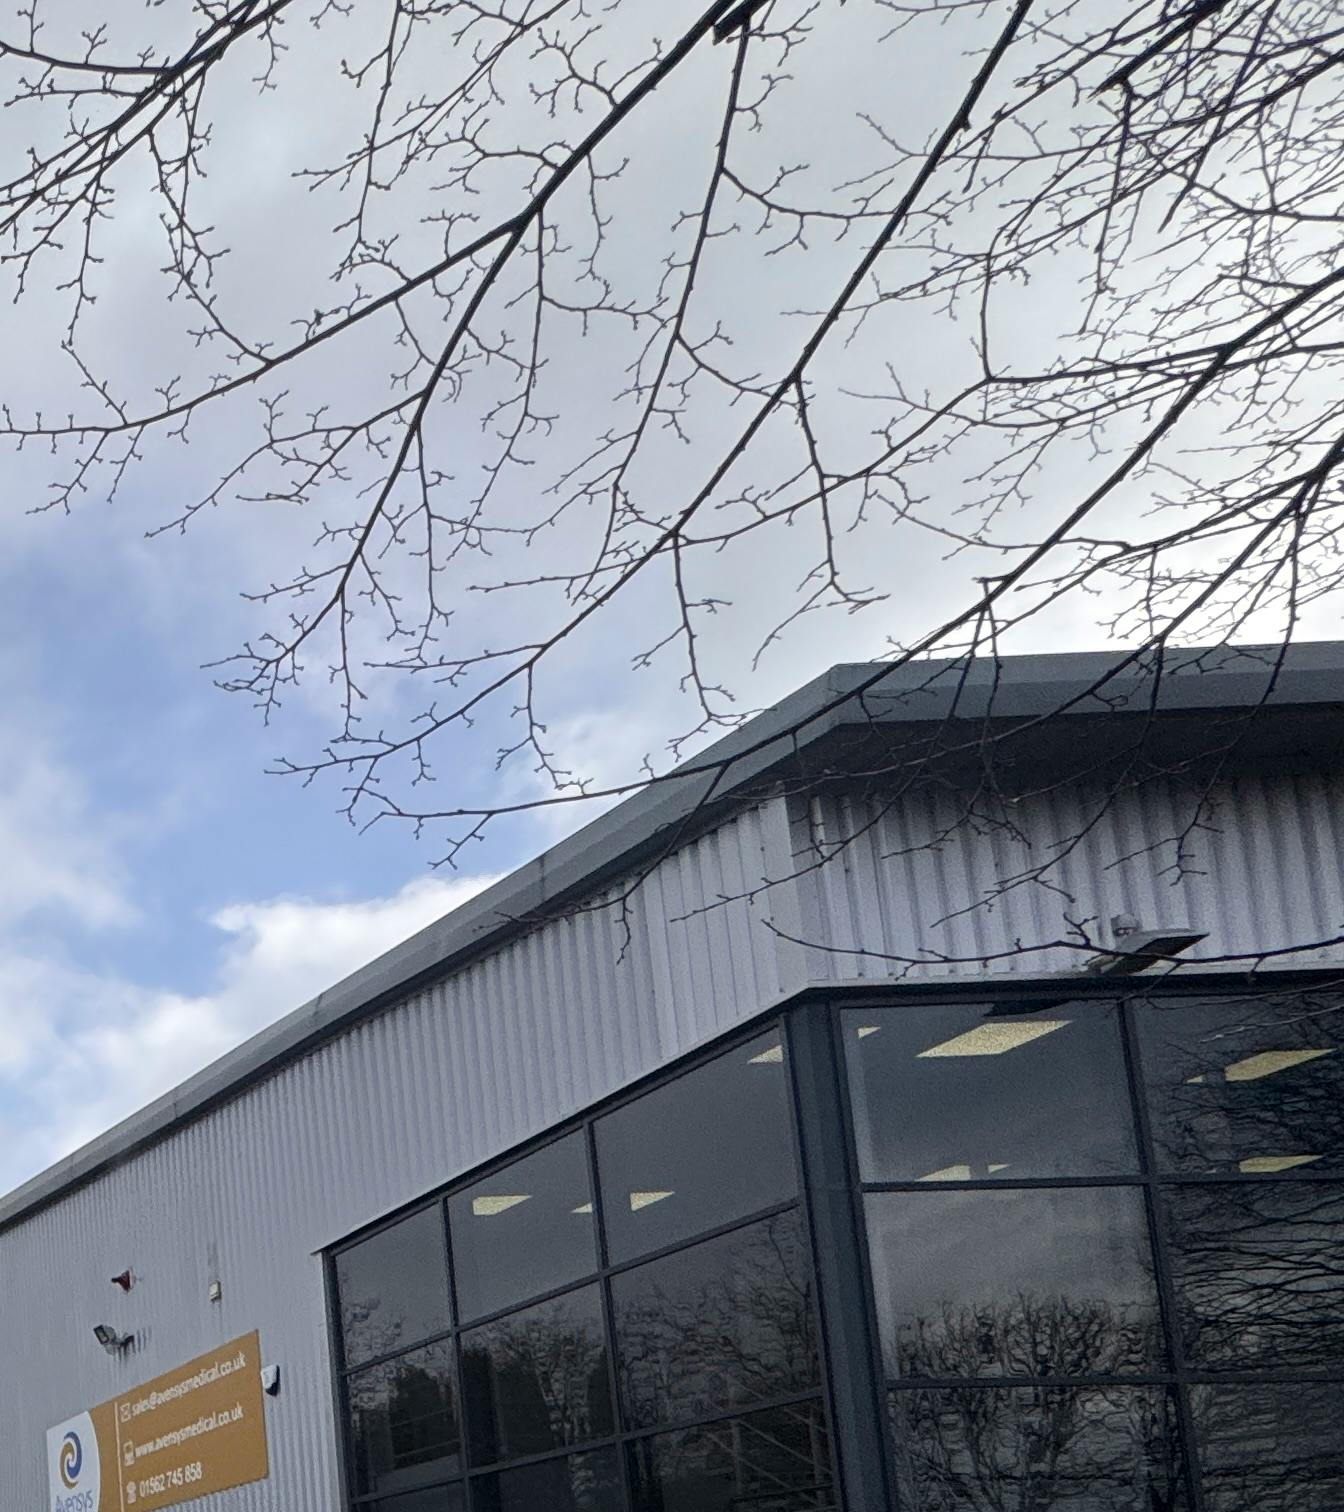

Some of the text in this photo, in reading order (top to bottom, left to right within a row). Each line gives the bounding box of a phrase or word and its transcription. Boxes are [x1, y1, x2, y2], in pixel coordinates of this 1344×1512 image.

[135, 1402, 244, 1458] www.avensysmedical.co.uk
[139, 1461, 203, 1498] 01562 745 858
